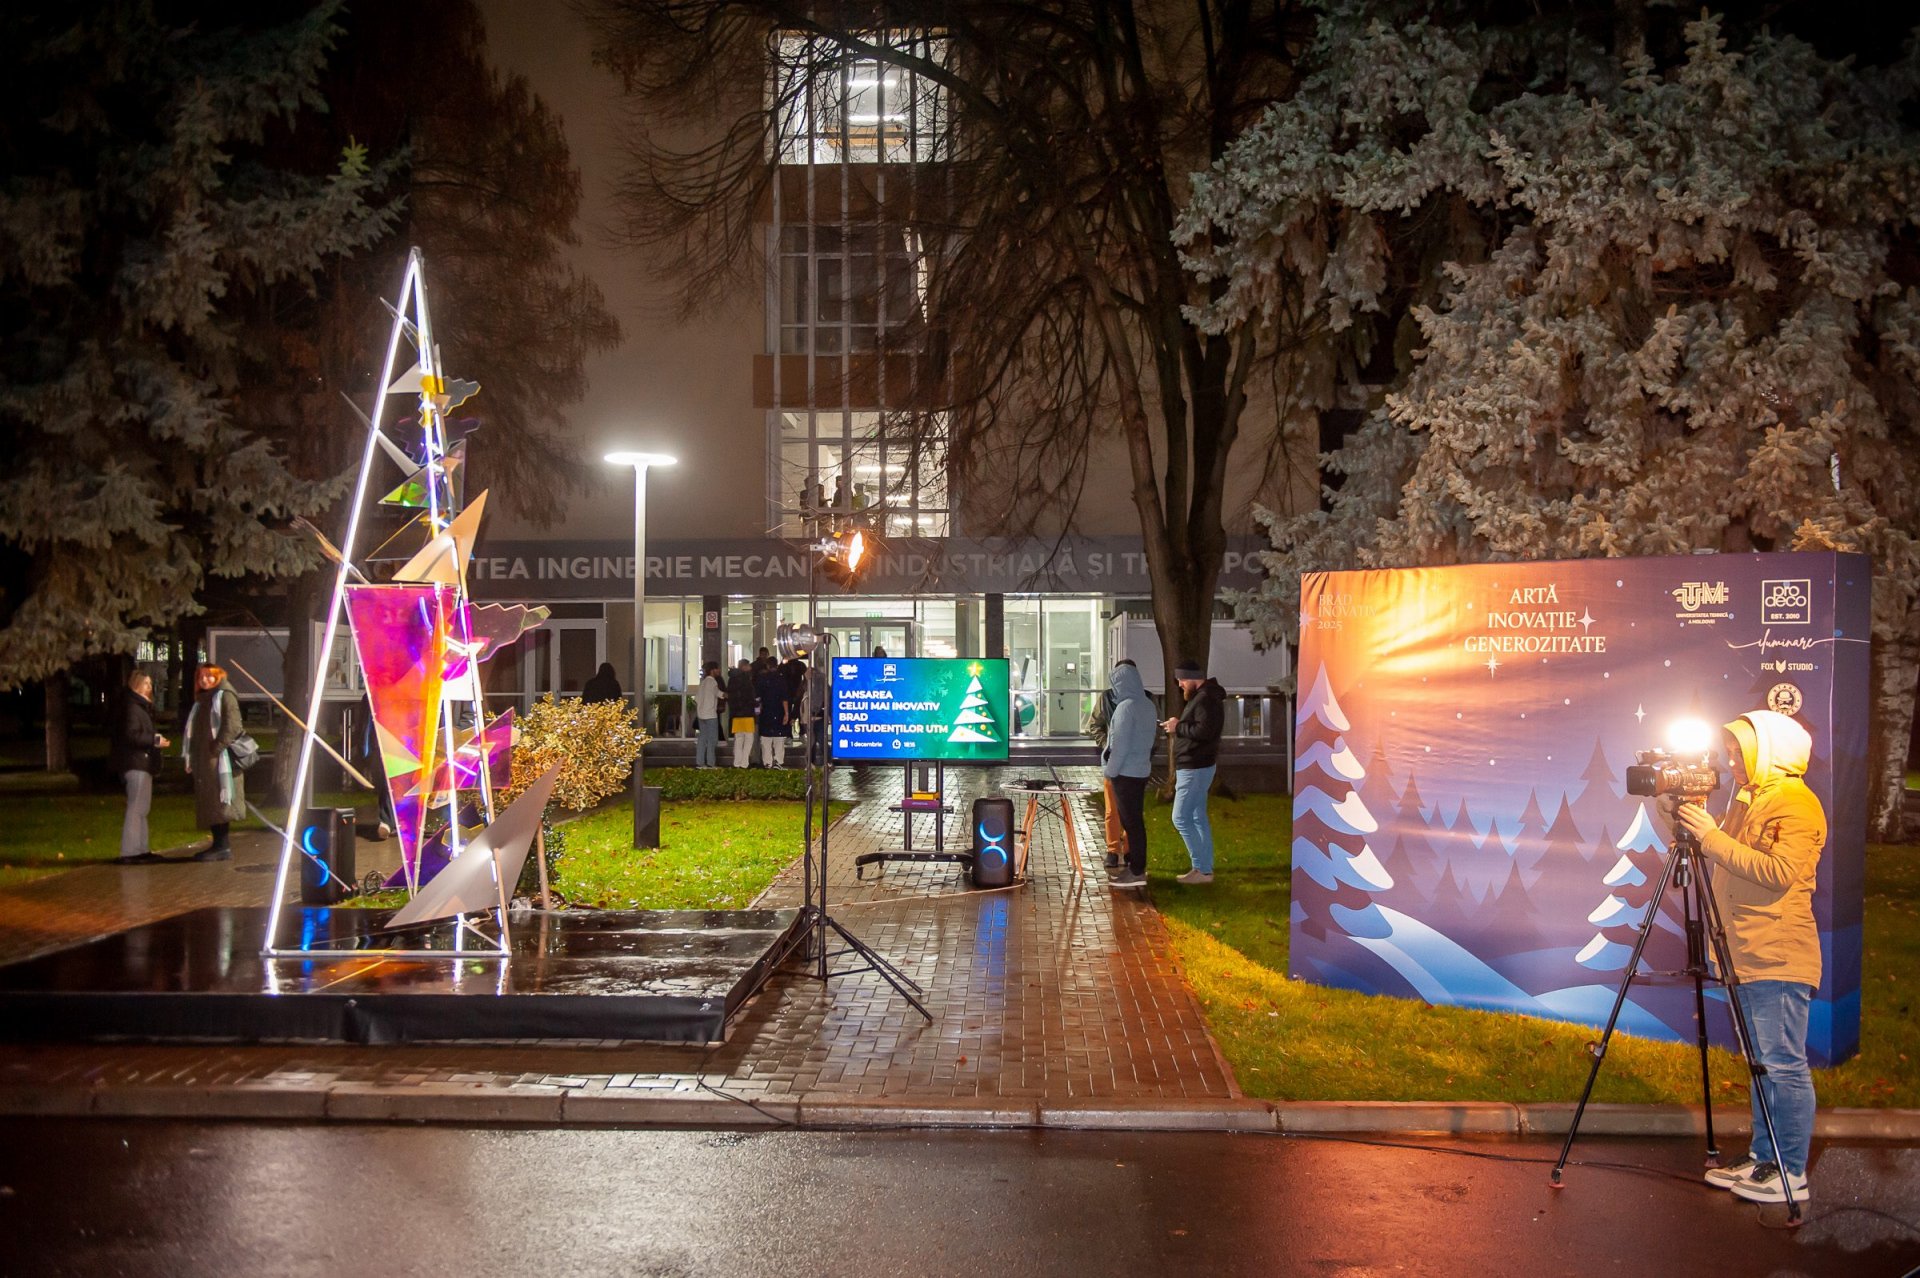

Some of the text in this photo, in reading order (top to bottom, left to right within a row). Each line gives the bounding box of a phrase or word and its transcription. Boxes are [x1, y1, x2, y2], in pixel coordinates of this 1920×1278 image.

[538, 556, 692, 580] INGINERIE
[700, 555, 807, 579] MECAN
[1509, 584, 1559, 604] ARTĂ
[1773, 585, 1800, 599] pro
[1765, 595, 1807, 607] deco
[1317, 621, 1343, 632] 2025
[1464, 636, 1606, 653] GENEROZITATE
[1761, 663, 1813, 671] FOX STUDIO
[839, 690, 893, 699] LANSAREA
[839, 702, 940, 711] CELUI MAI INOVATIV
[839, 713, 868, 721] BRAD
[839, 724, 852, 733] AL
[926, 724, 948, 733] UTM
